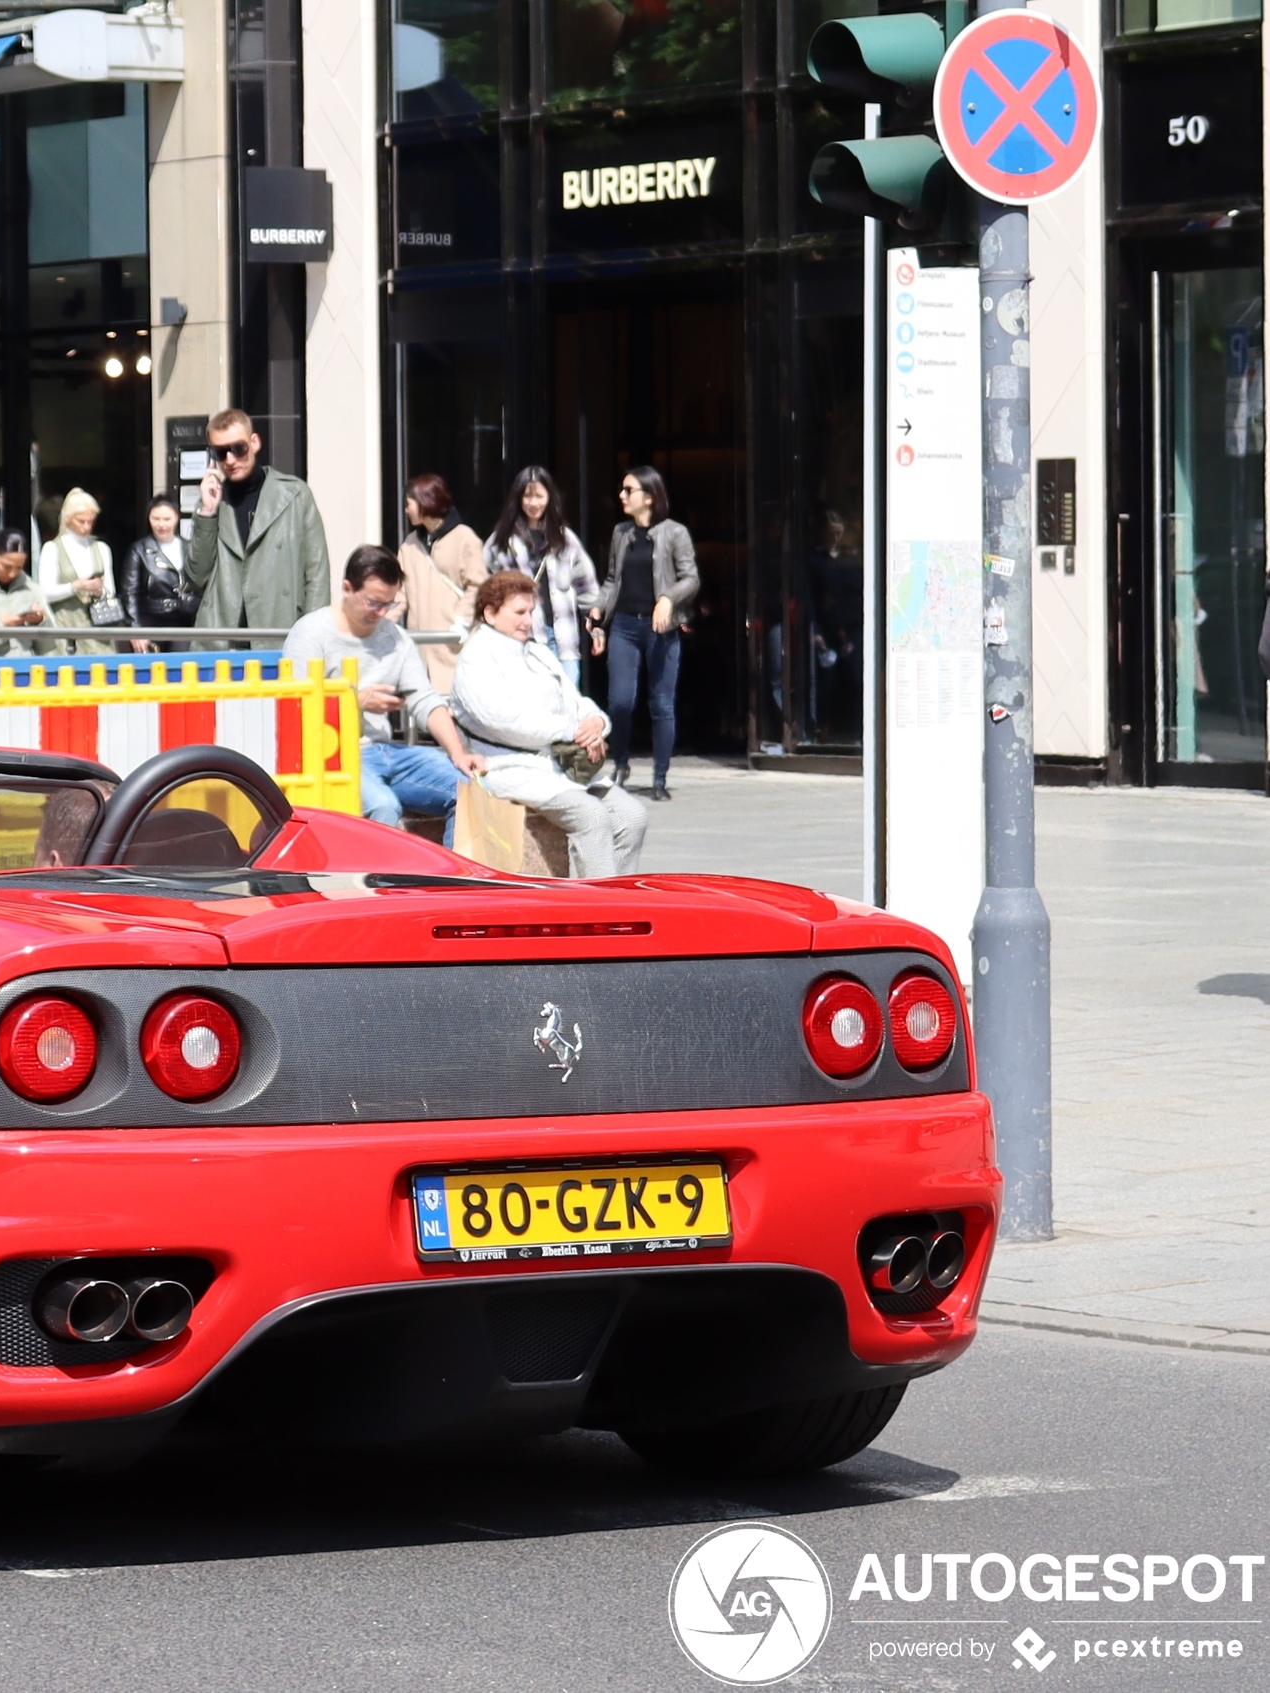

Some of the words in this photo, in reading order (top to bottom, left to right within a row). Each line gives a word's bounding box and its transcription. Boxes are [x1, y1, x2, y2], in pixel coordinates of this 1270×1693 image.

[1168, 115, 1209, 147] 50
[563, 157, 716, 210] BURBERRY
[250, 228, 327, 245] BURBERRY
[461, 1174, 703, 1238] 80-GZK-9
[423, 1220, 446, 1237] NL
[471, 1249, 507, 1261] Ferrari
[541, 1245, 578, 1257] Eberlein
[583, 1243, 612, 1255] Kassel
